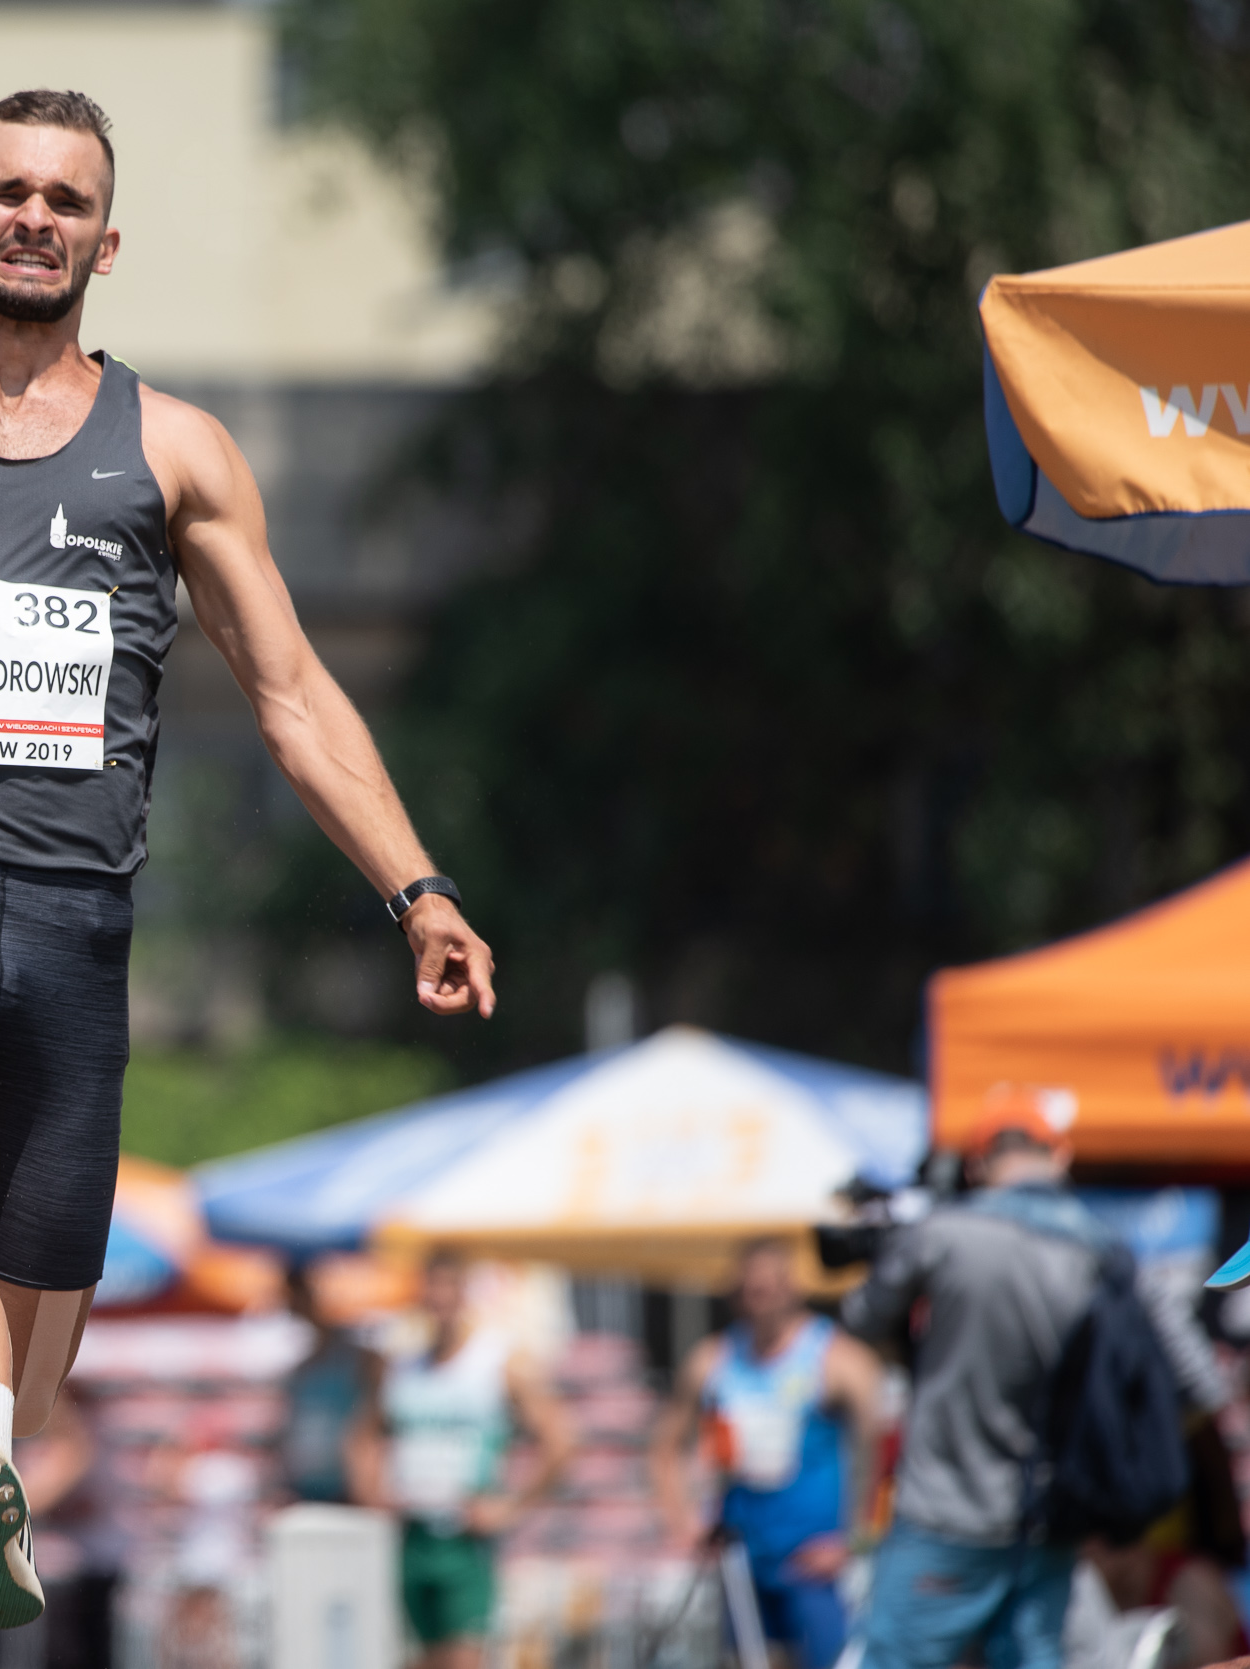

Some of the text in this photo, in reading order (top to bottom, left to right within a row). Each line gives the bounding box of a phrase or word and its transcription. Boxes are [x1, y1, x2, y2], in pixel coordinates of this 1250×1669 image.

[66, 534, 123, 556] OPOLSKIE
[14, 592, 100, 634] 382
[6, 723, 58, 732] WIELOBOJACH
[61, 726, 101, 734] SZTAFETACH
[25, 742, 73, 761] 2019
